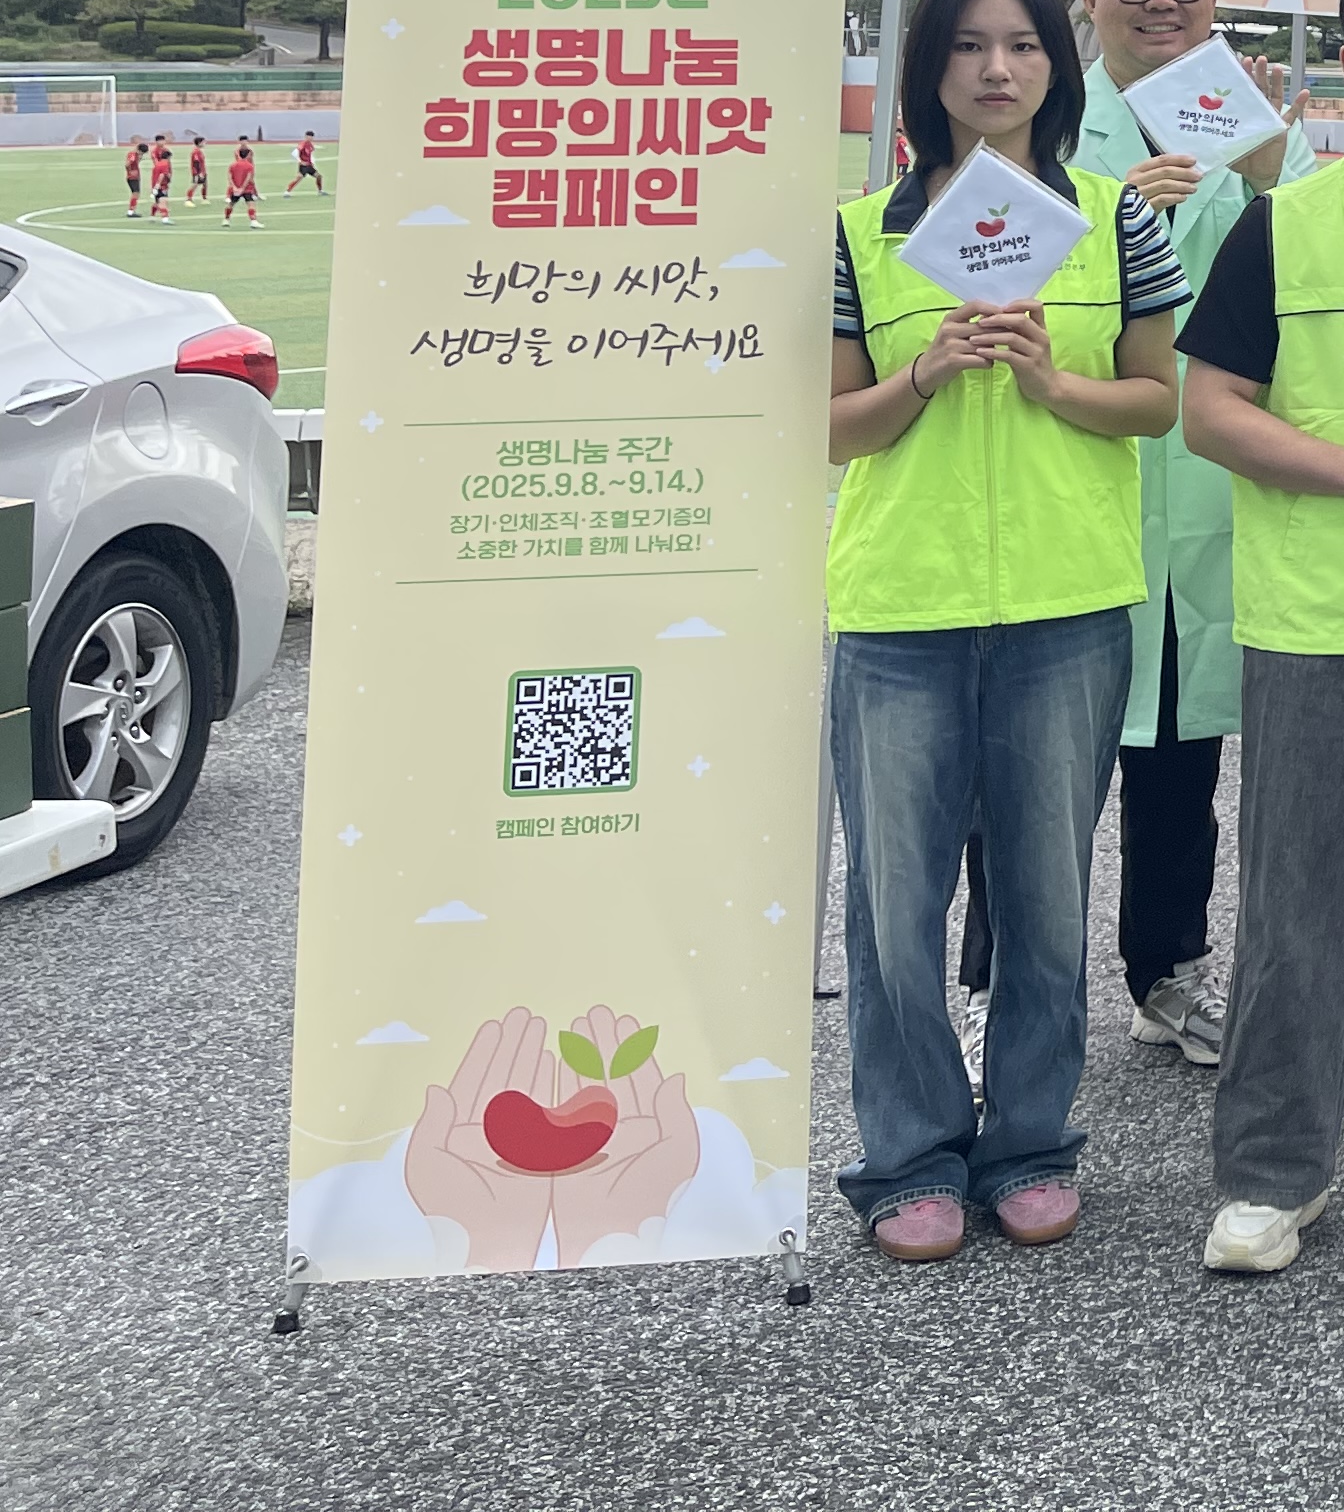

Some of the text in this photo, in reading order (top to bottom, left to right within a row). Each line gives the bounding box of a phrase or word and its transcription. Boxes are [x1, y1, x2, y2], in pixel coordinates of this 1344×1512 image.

[463, 29, 739, 87] 생명나눔
[423, 97, 772, 158] 희망의씨앗
[492, 167, 698, 228] 캠페인
[958, 234, 1031, 260] 희망의씨앗
[463, 256, 720, 304] 희망의 씨앗,
[410, 323, 764, 367] 생명을 이어주세요
[496, 436, 673, 467] 생명나눔 주간
[461, 468, 704, 501] (2025.9.8.~9.14.)
[456, 533, 701, 561] 소중한 가치를 함께 나눠요!
[496, 813, 640, 839] 캠페인 참여하기
